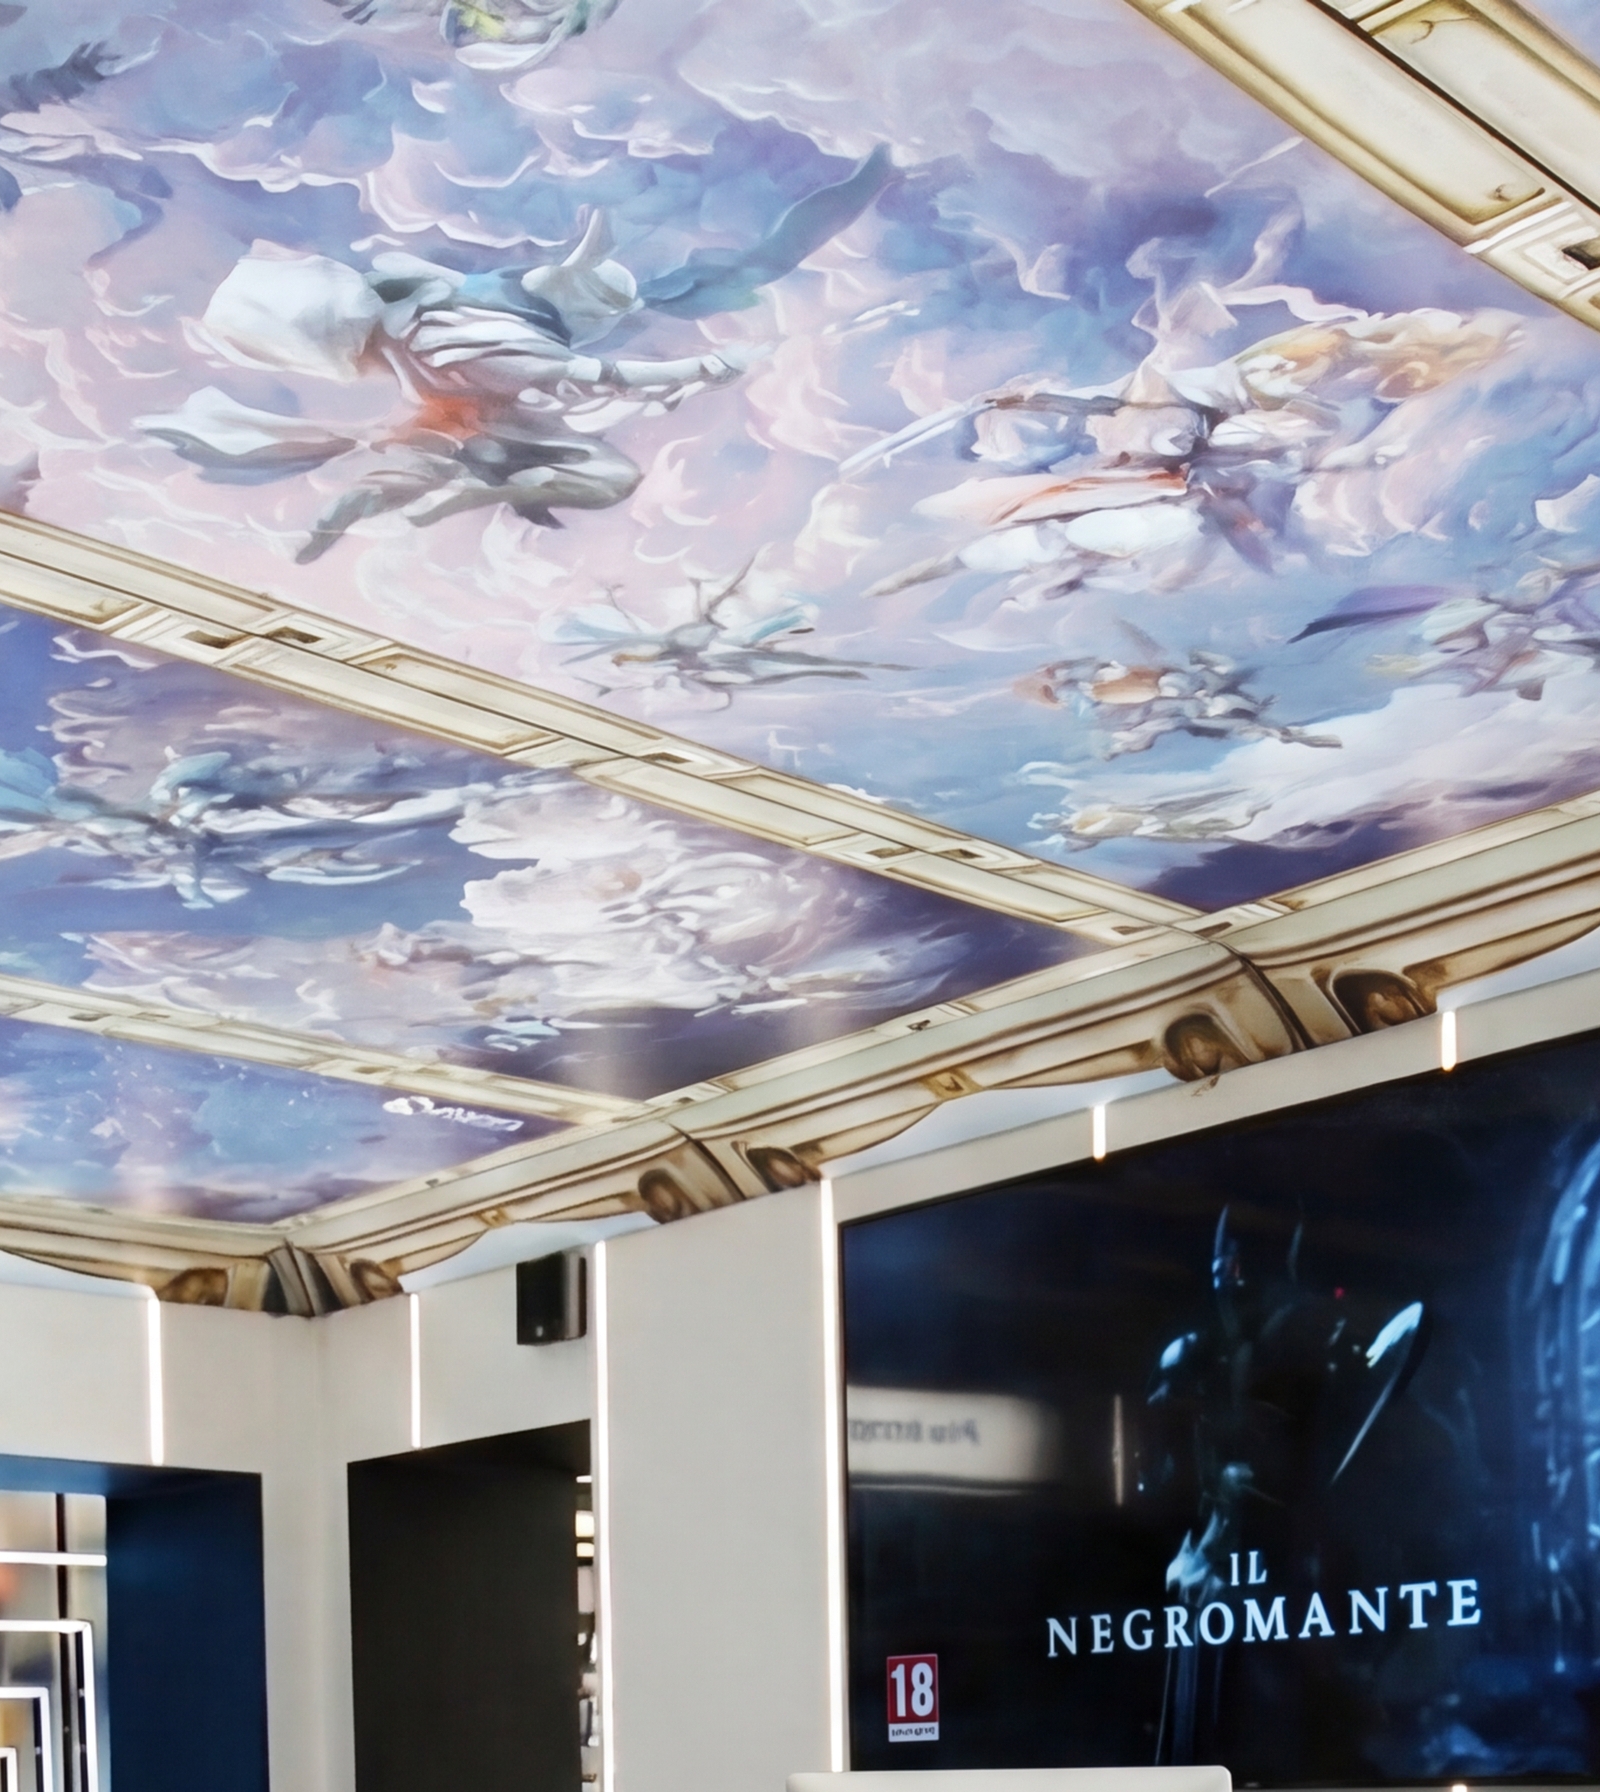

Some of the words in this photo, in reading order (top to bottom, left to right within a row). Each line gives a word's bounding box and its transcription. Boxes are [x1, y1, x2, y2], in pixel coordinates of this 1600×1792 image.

[1229, 1550, 1268, 1587] IL
[1046, 1579, 1482, 1658] NEGROMANTE
[890, 1661, 935, 1718] 18
